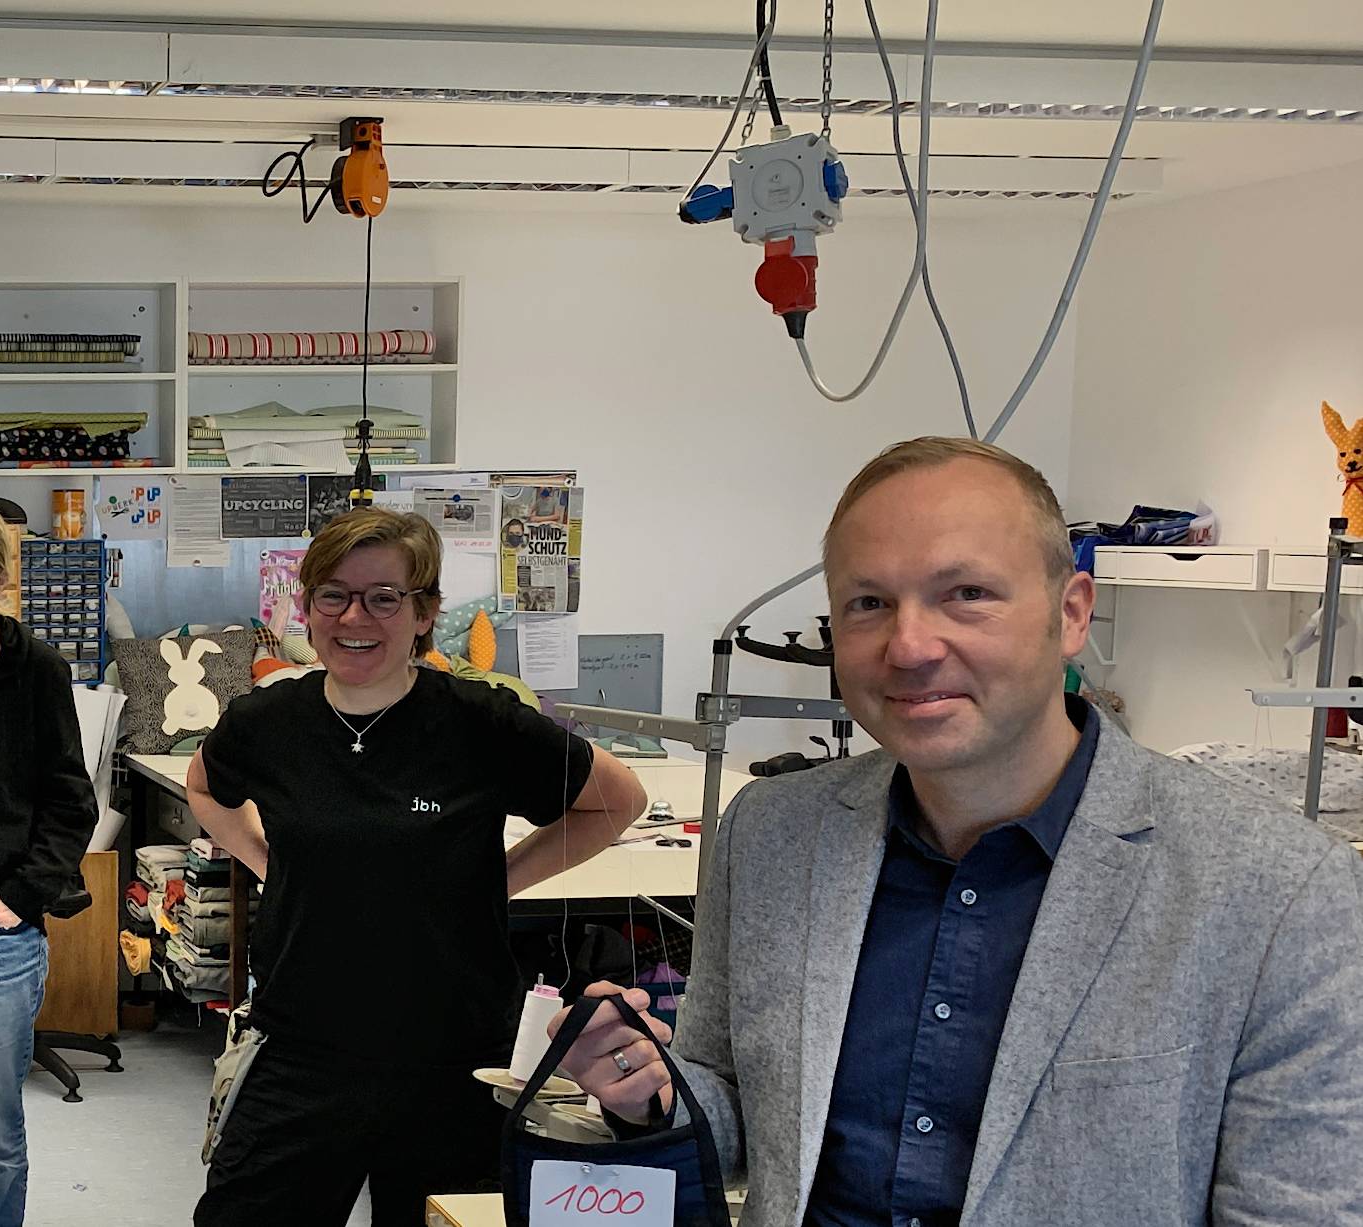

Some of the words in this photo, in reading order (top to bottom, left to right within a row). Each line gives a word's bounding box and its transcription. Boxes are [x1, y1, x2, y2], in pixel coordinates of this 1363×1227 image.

[223, 499, 305, 511] UPCYCLING
[530, 526, 567, 541] MUND-
[528, 541, 567, 555] SCHUTZ
[410, 796, 441, 813] jbh
[545, 1184, 645, 1215] 1000
